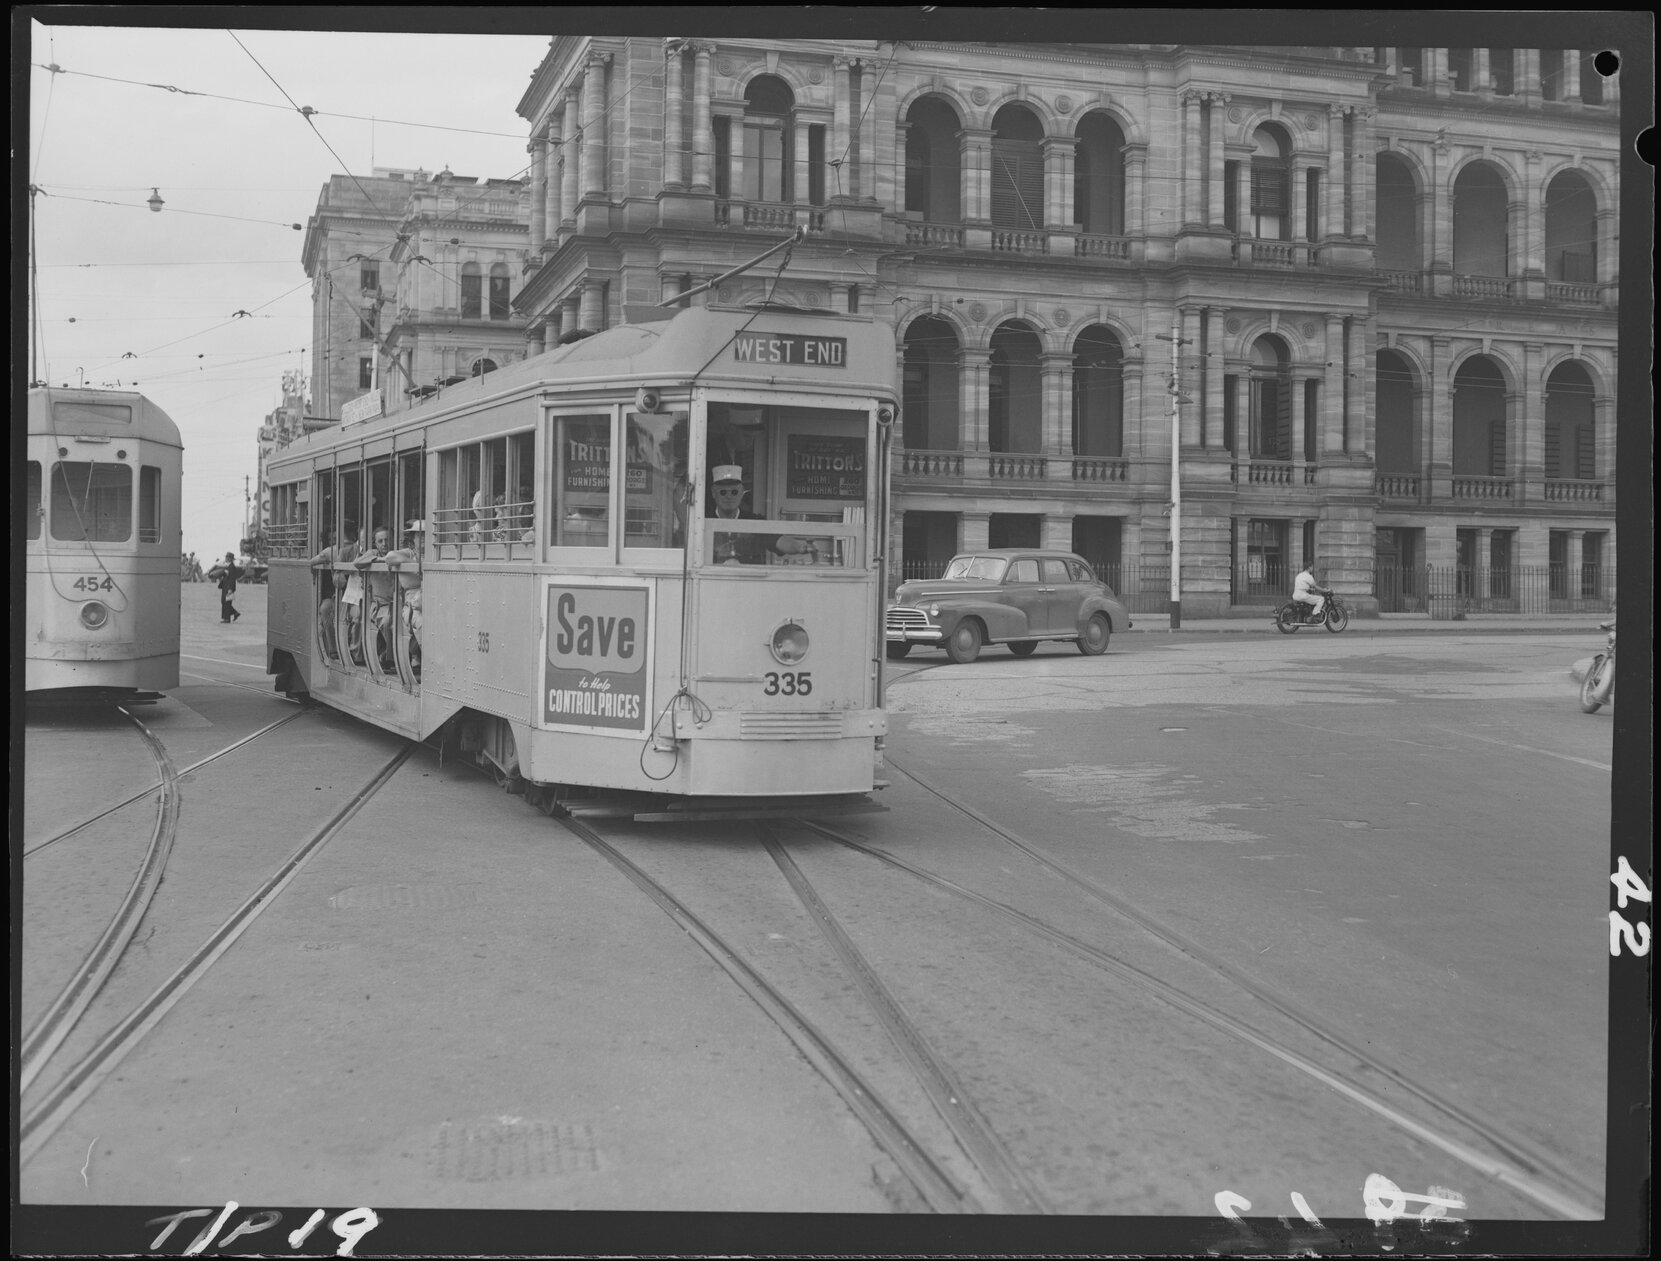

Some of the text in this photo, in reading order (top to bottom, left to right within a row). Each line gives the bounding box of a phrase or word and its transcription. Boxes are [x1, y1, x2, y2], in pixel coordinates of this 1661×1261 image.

[737, 338, 843, 365] WEST END
[793, 450, 864, 471] TRITTONS
[73, 577, 113, 593] 454
[556, 592, 636, 660] Save
[476, 631, 490, 654] 335
[578, 675, 612, 693] to Help
[763, 671, 813, 697] 335
[549, 689, 640, 719] CONTROL PRICES
[1609, 855, 1652, 957] 42
